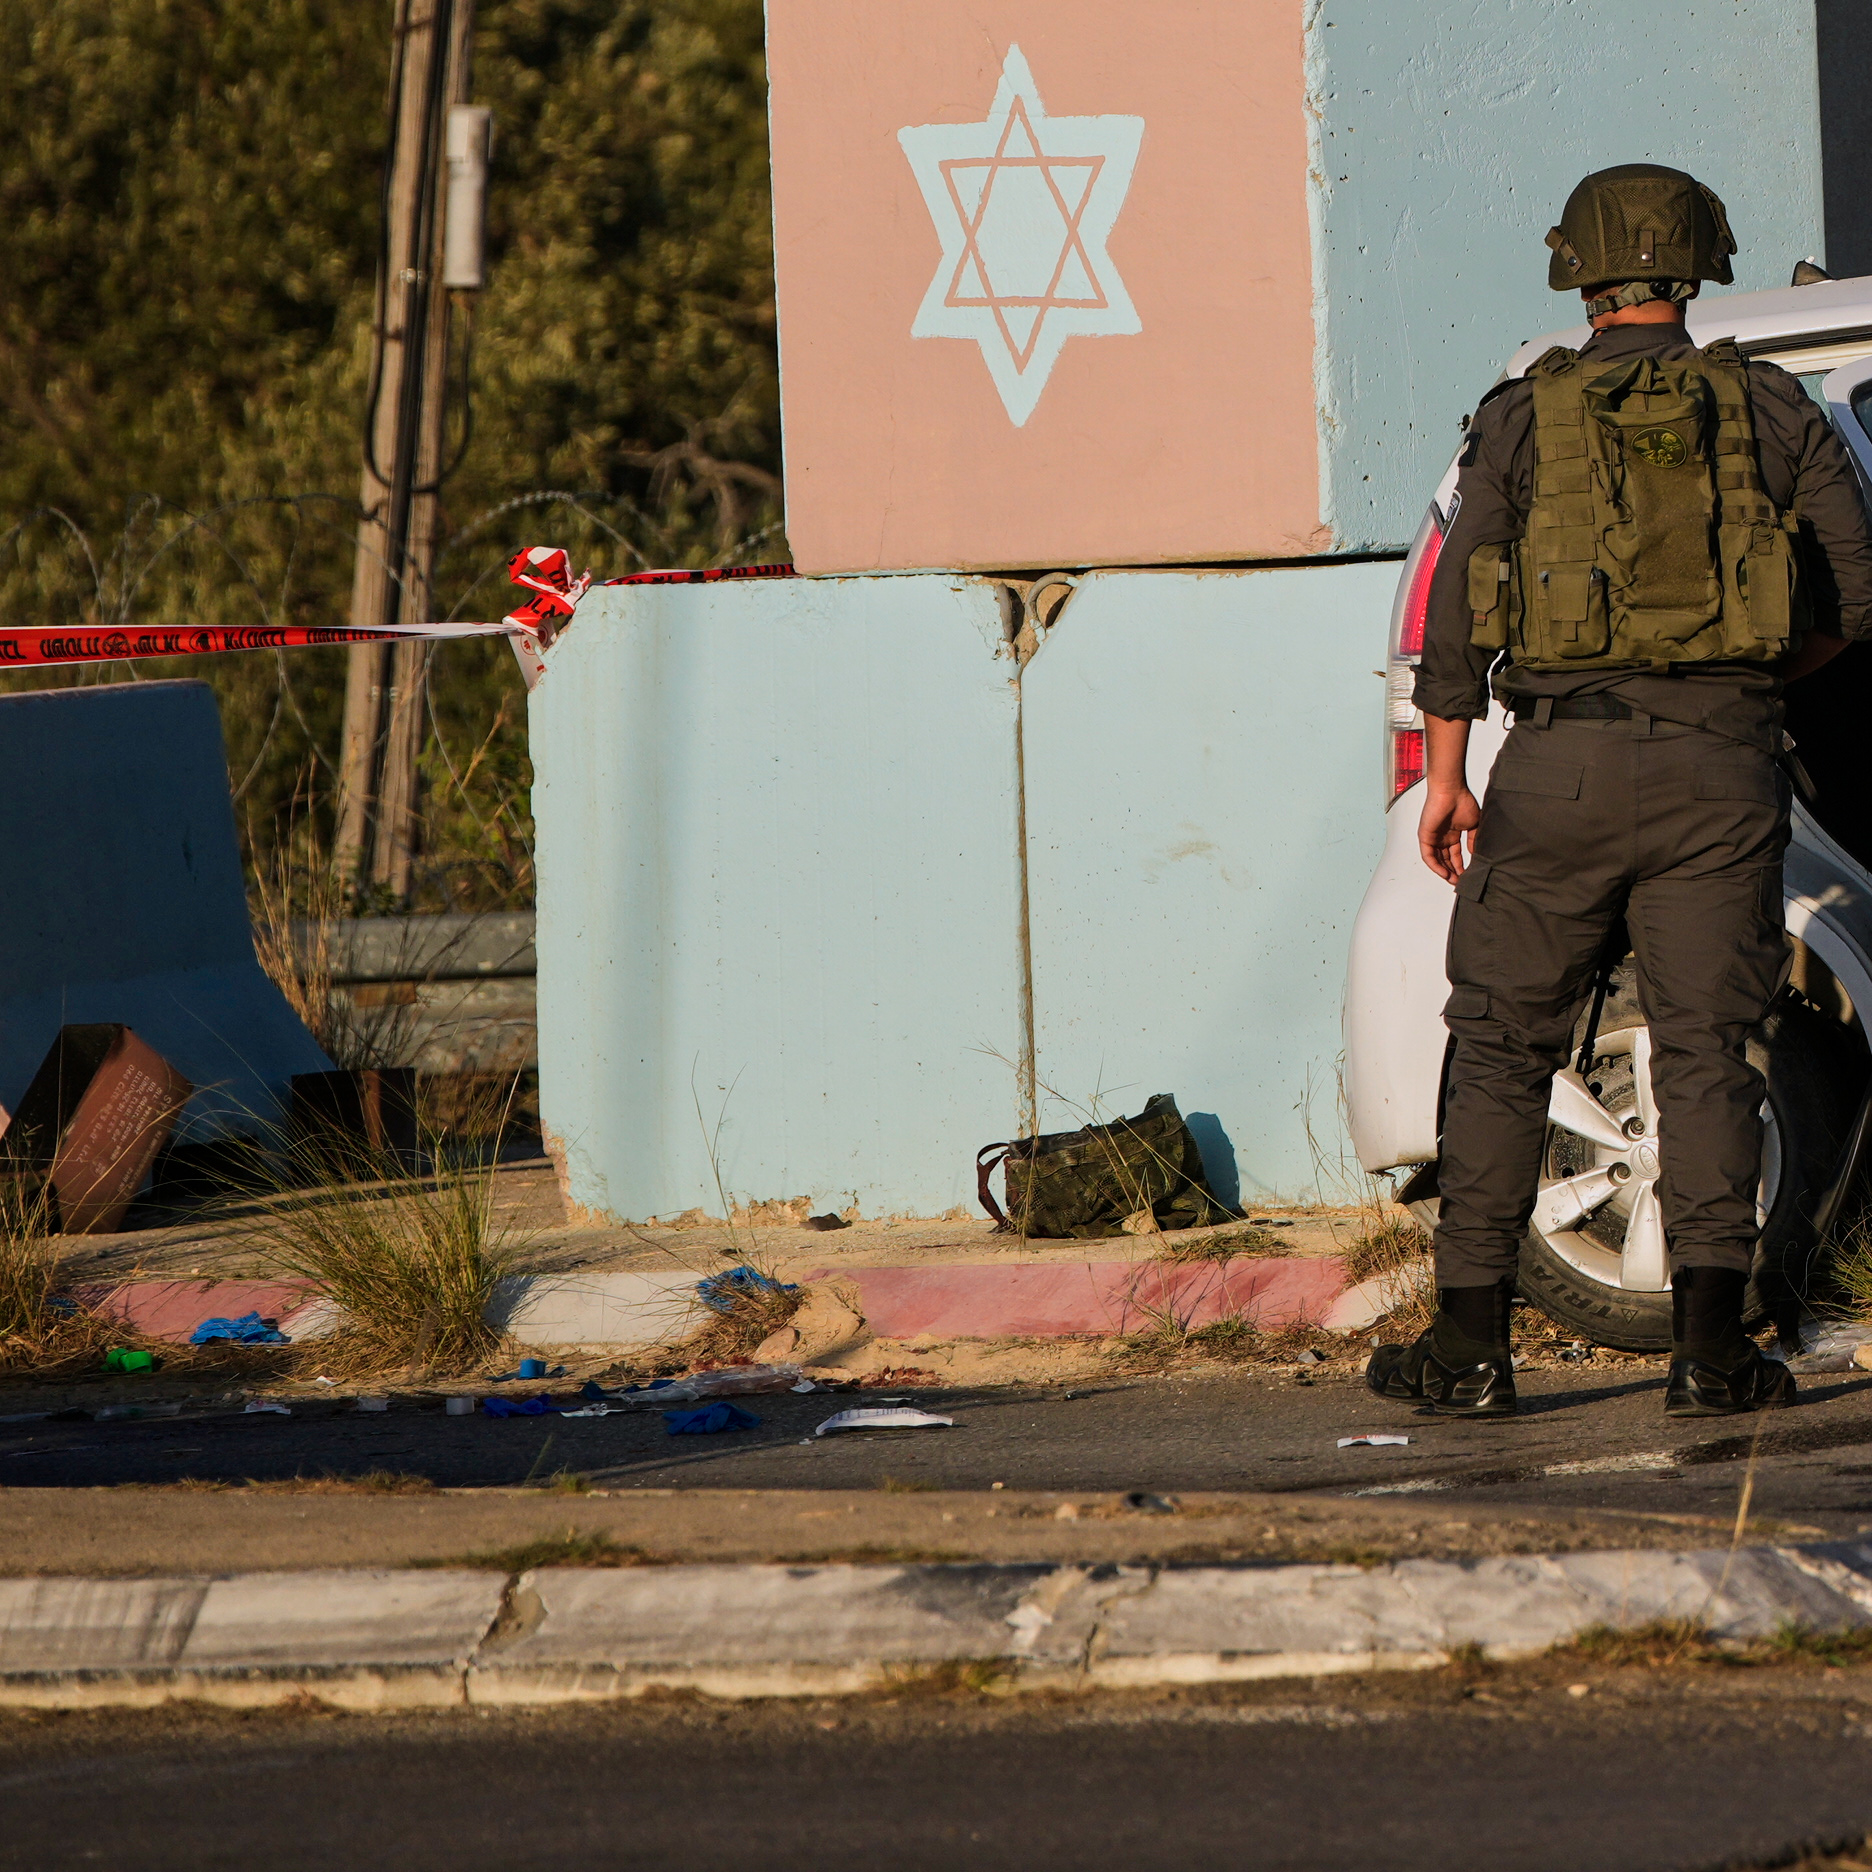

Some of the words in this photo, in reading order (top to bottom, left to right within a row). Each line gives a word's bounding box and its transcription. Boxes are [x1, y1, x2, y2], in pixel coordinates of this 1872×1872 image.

[0, 640, 28, 659] בר
[40, 636, 102, 659] משטרת
[133, 634, 190, 654] ישראל
